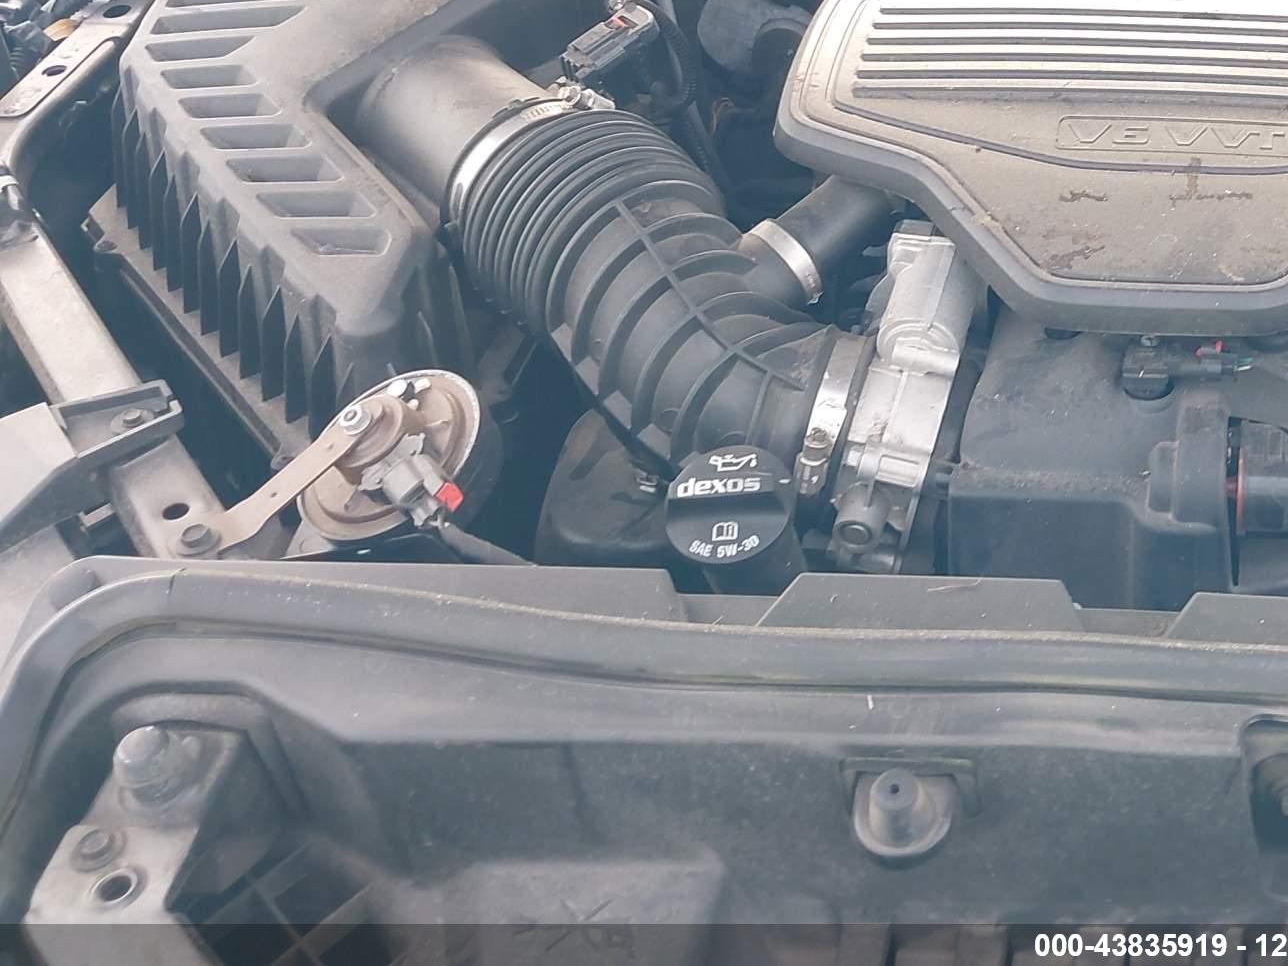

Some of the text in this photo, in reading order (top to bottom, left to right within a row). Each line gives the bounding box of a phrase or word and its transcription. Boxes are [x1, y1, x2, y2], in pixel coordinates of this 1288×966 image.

[1067, 122, 1286, 150] V6 VVT
[677, 477, 761, 498] dexos
[688, 535, 760, 558] SAE 5W-30
